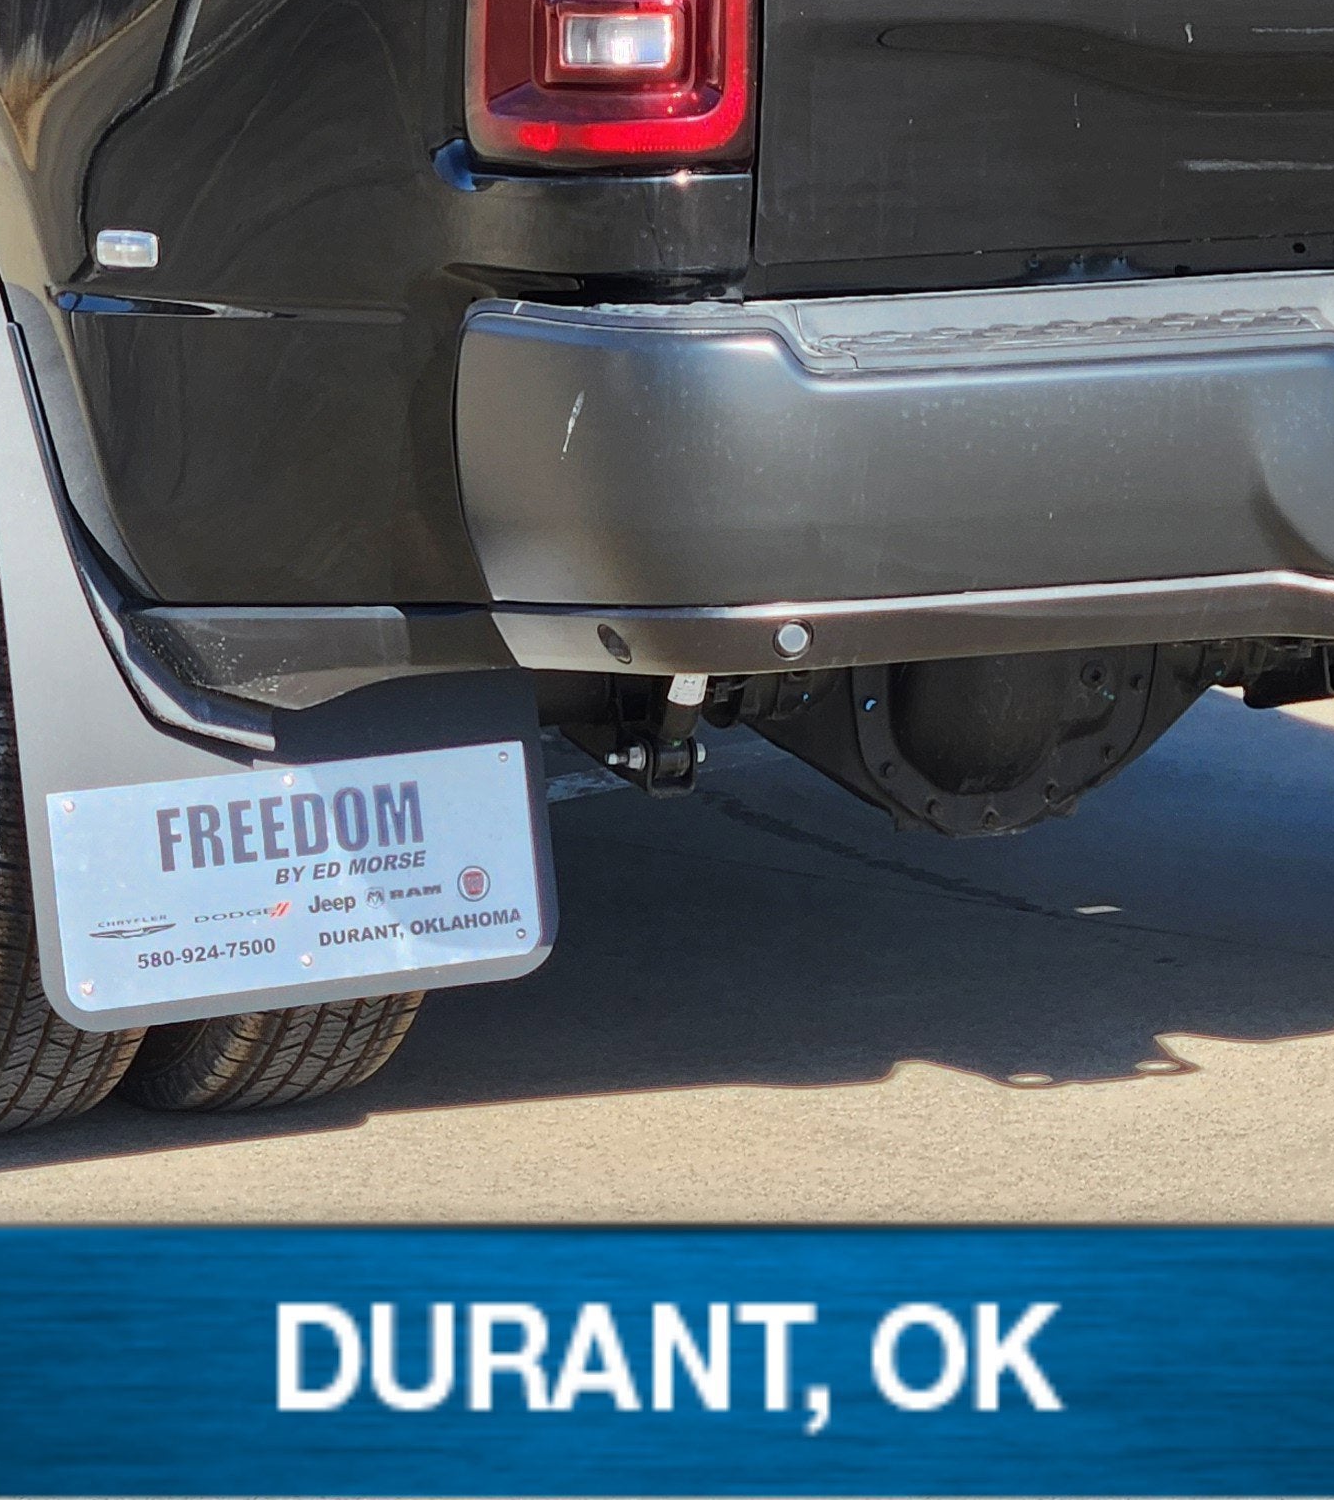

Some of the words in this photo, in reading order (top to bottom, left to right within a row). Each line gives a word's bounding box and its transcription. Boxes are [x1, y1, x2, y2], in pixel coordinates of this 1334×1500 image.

[155, 779, 425, 873] FREEDOM
[275, 864, 306, 885] BY
[312, 861, 341, 881] ED
[348, 850, 427, 876] MORSE
[194, 906, 275, 924] DODGE
[308, 894, 356, 914] Jeep
[389, 884, 443, 900] RAM
[318, 922, 405, 947] DURANT,
[409, 908, 522, 936] OKLAHOMA
[137, 937, 276, 970] 580-924-7500
